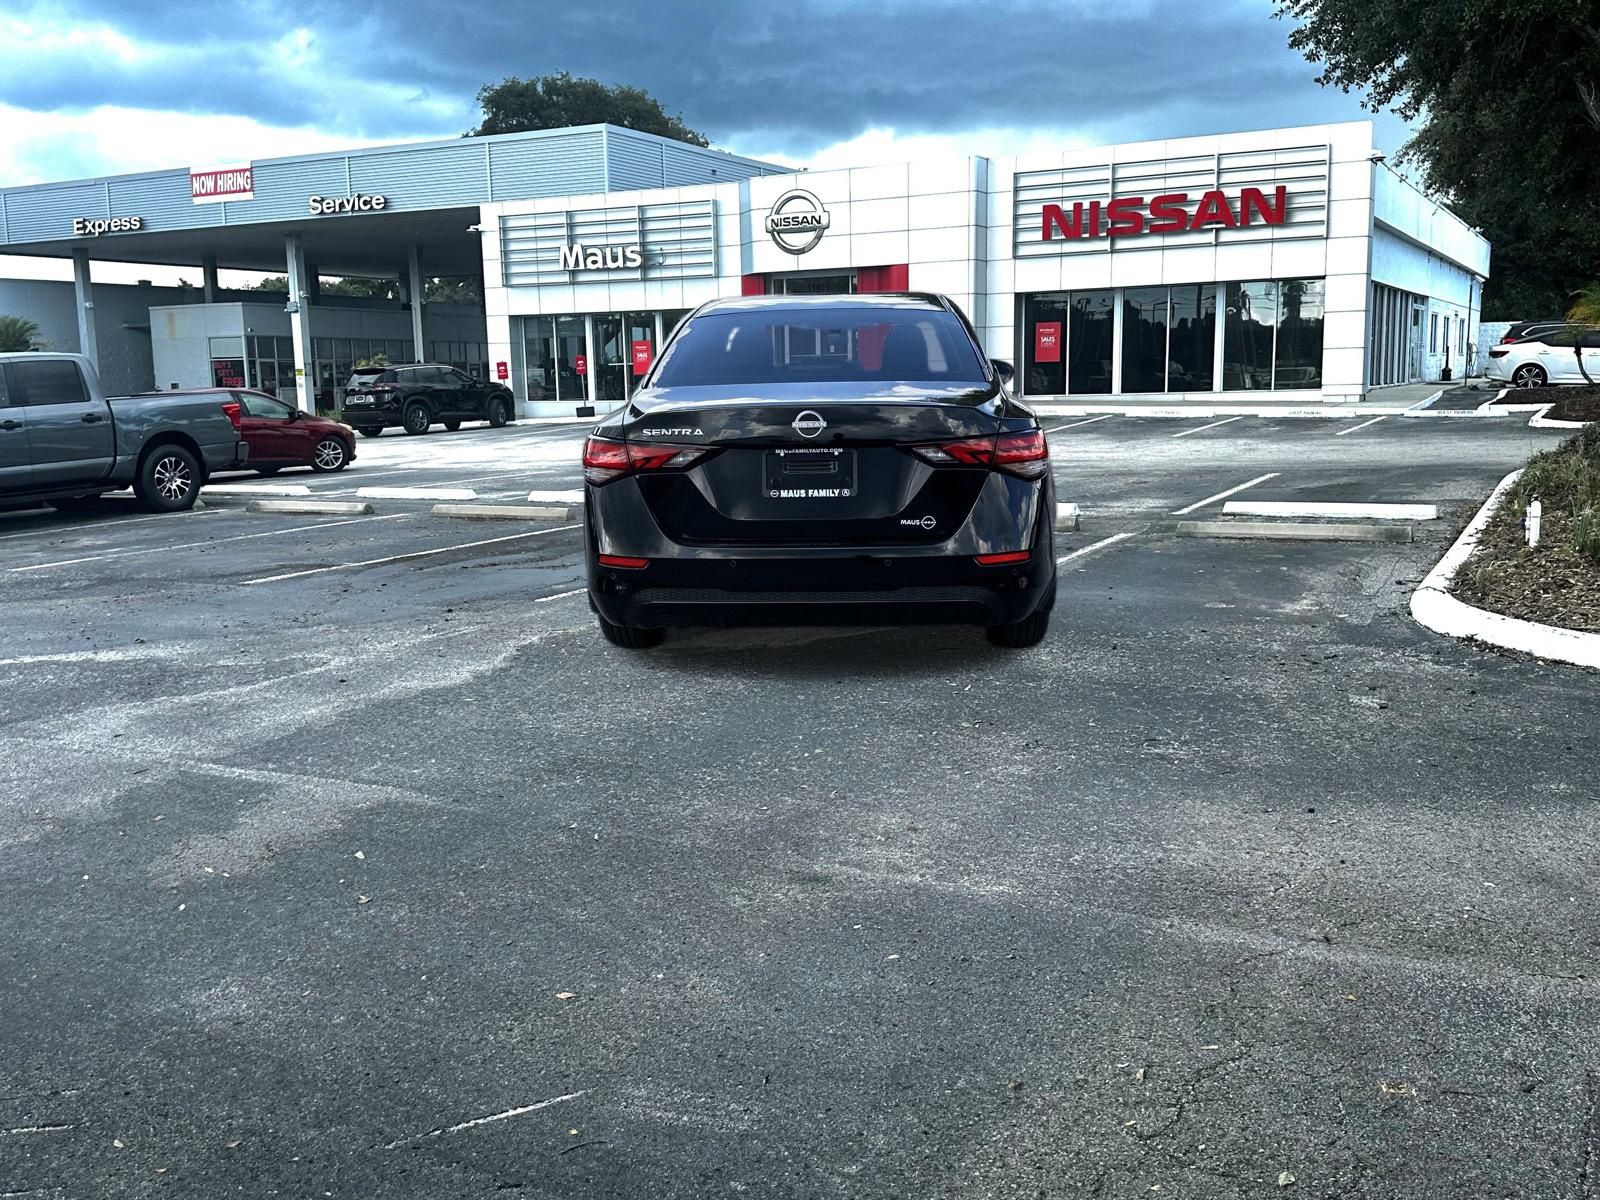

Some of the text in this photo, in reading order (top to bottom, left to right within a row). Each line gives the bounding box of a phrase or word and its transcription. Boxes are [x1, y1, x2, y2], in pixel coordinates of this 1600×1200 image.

[192, 171, 251, 195] NOW HIRING
[309, 193, 385, 215] Service
[770, 215, 822, 228] NISSAN
[1042, 185, 1287, 241] NISSAN
[73, 216, 141, 237] Express
[559, 243, 642, 270] Maus
[223, 377, 245, 387] FREE
[642, 428, 704, 437] SENTRA
[792, 421, 828, 429] NISSAN
[780, 489, 840, 498] MAUS FAMILY
